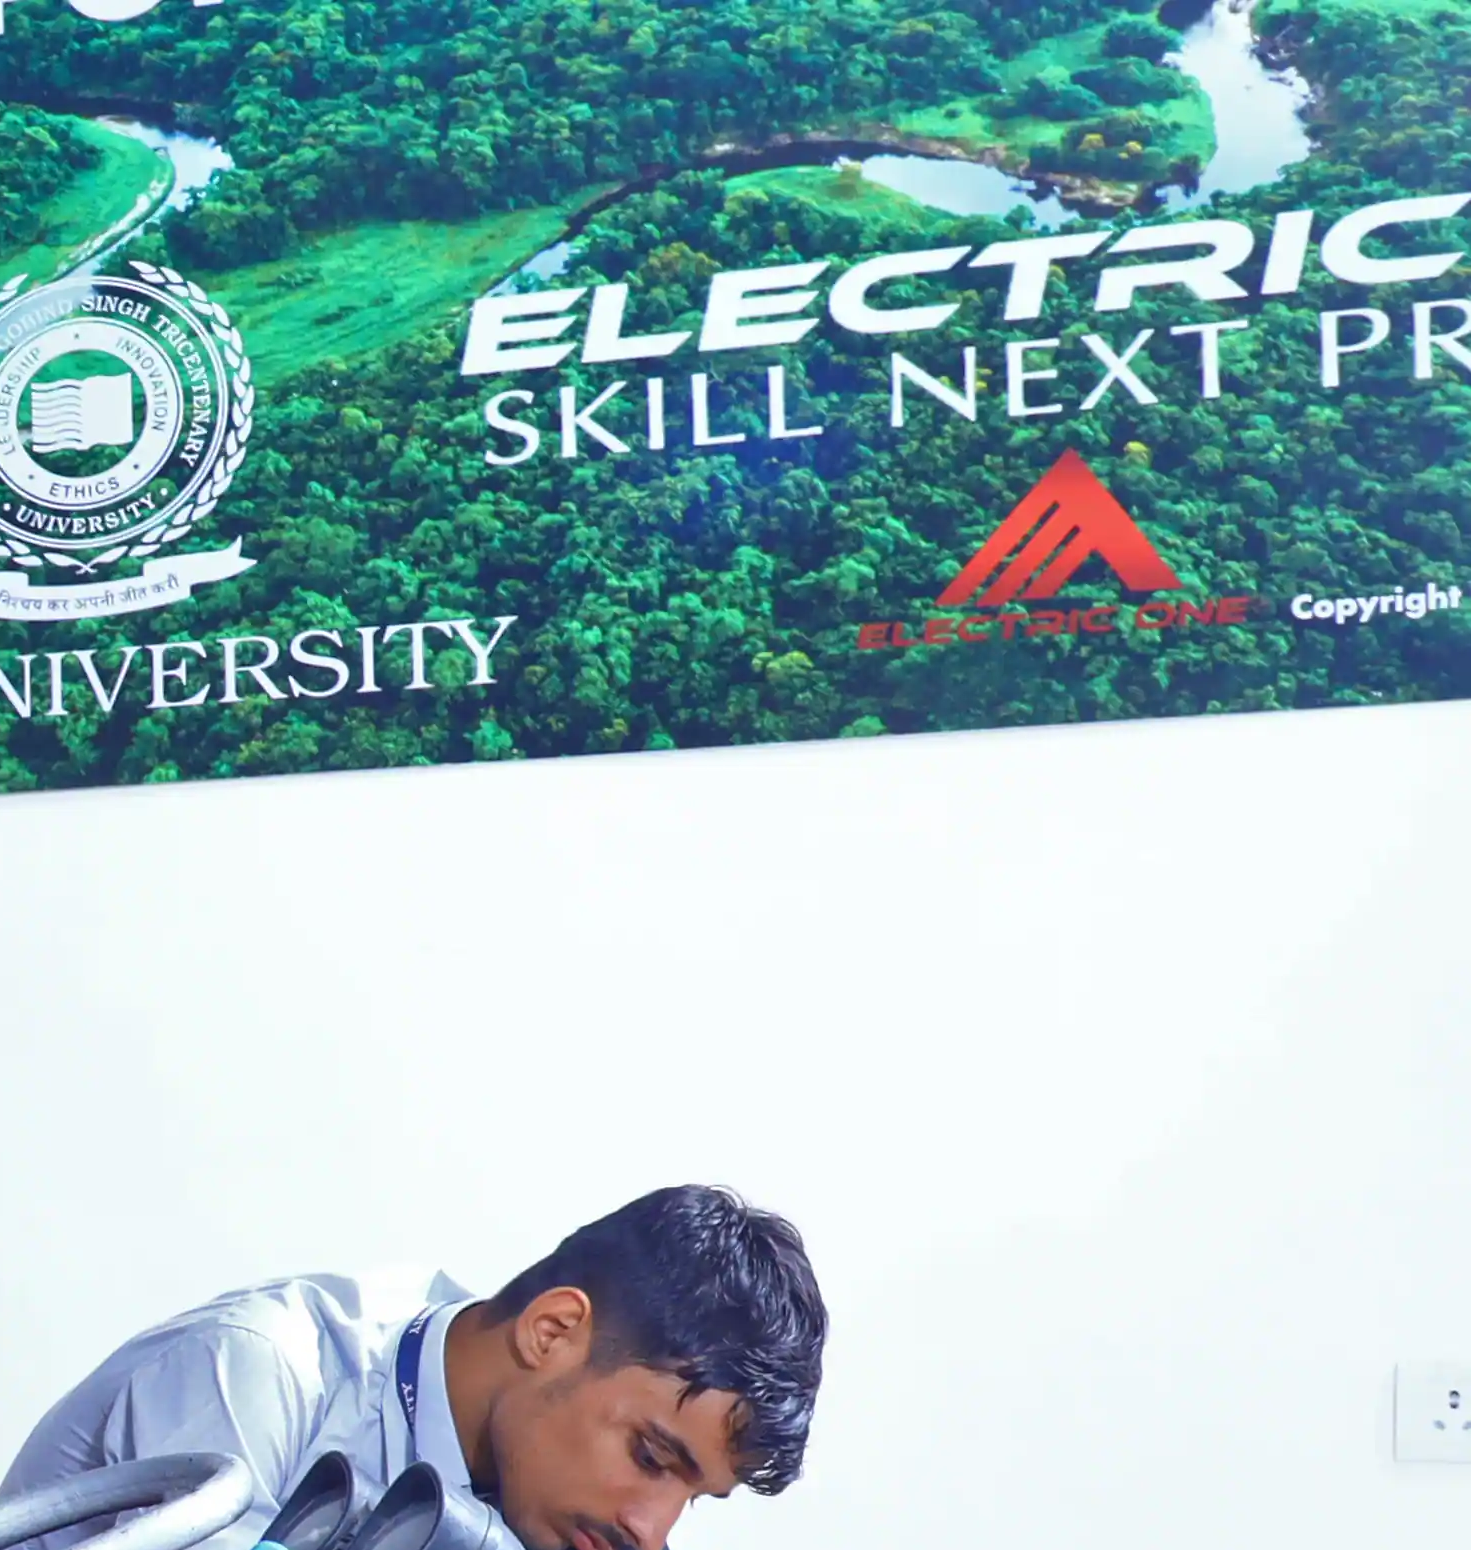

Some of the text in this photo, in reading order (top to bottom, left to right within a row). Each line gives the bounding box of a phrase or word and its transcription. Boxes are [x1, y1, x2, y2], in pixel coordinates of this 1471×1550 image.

[461, 192, 1471, 375] ELECTRIC
[80, 295, 152, 322] SINGH
[151, 314, 212, 468] TRICENTENARY
[115, 336, 168, 432] INNOVATION
[484, 365, 823, 465] SKILL
[891, 320, 1249, 428] NEXT
[15, 492, 156, 535] UNIVERSITY
[49, 477, 120, 498] ETHICS
[858, 596, 1250, 650] ELECTRIC ONE
[1290, 582, 1463, 625] Copyright
